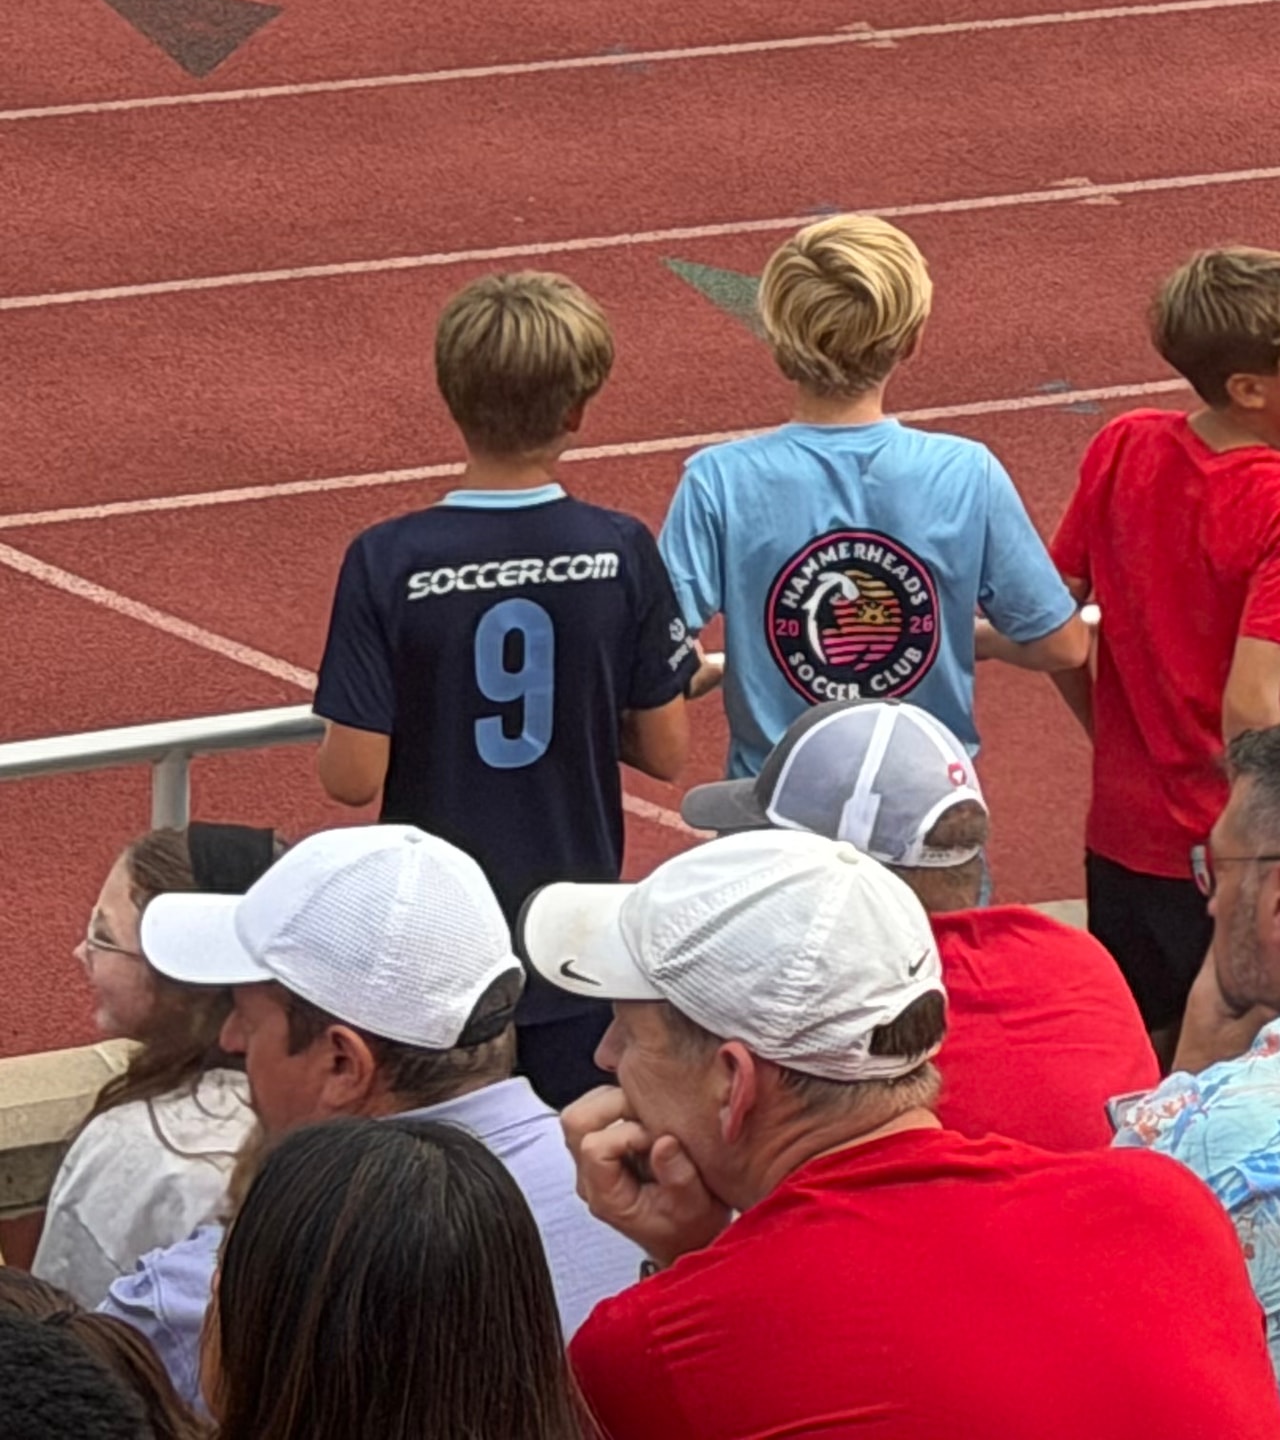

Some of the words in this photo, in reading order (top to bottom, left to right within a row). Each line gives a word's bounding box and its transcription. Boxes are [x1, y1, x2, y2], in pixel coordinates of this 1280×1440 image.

[407, 552, 620, 601] SOCCER.COM
[780, 542, 929, 609] HAMMERHEADS
[775, 619, 800, 637] 20
[474, 597, 555, 770] 9
[788, 652, 861, 700] SOCCER
[870, 647, 923, 692] CLUB
